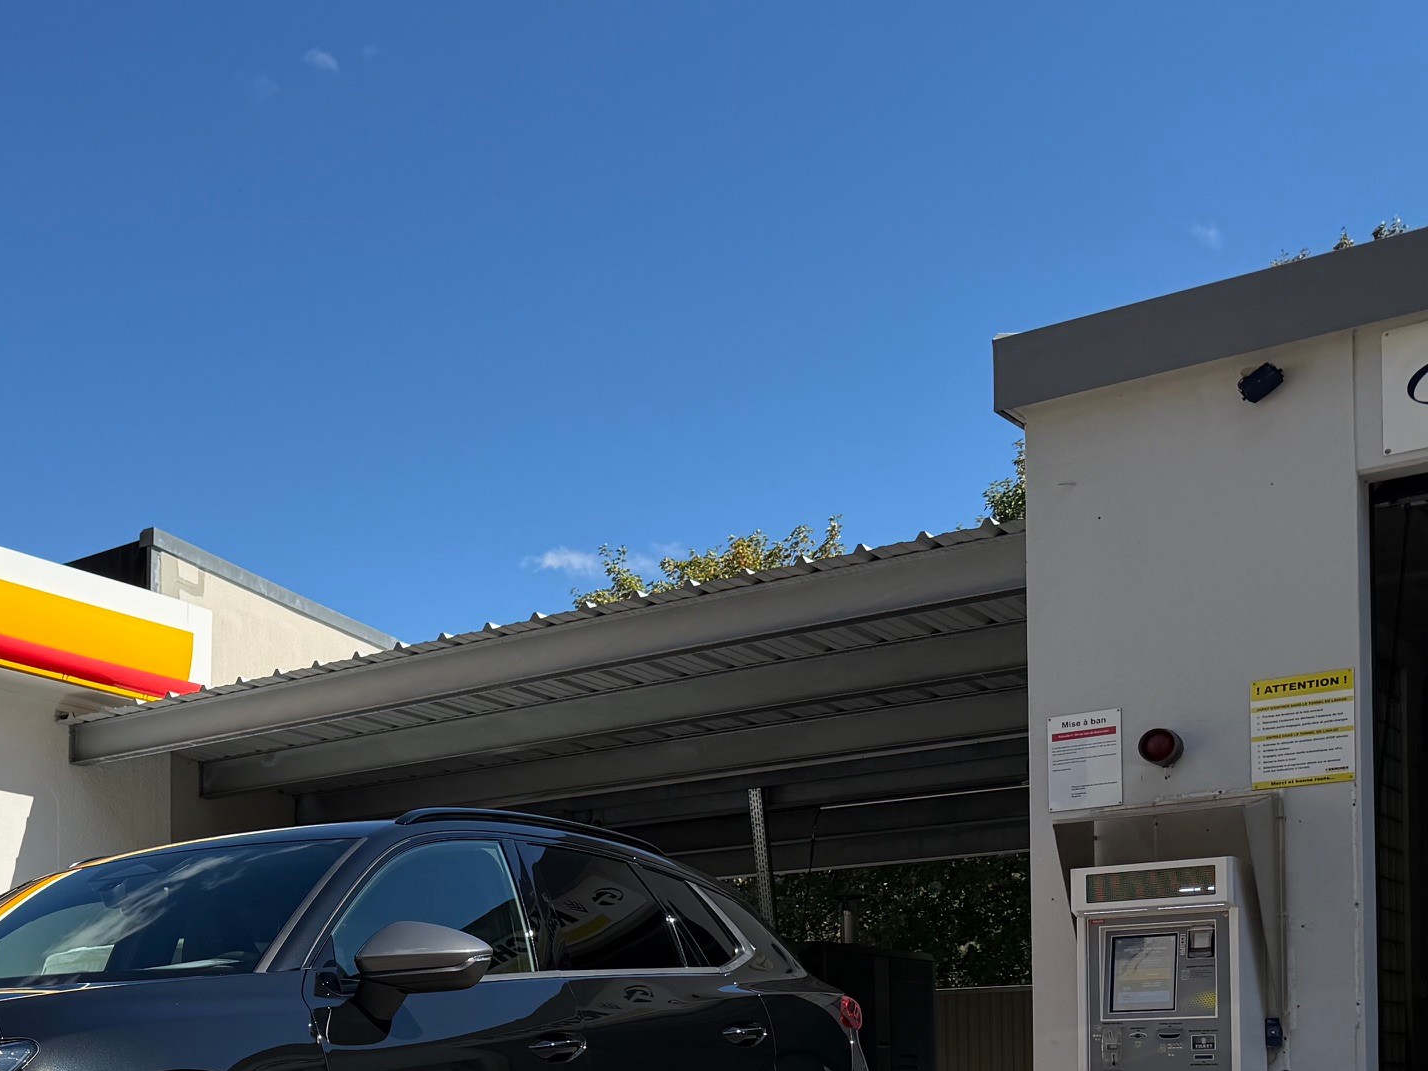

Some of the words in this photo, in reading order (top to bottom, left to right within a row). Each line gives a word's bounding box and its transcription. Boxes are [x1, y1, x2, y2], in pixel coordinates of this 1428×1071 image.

[1264, 677, 1339, 694] ATTENTION
[1061, 720, 1081, 729] Mise
[1090, 717, 1107, 725] ban
